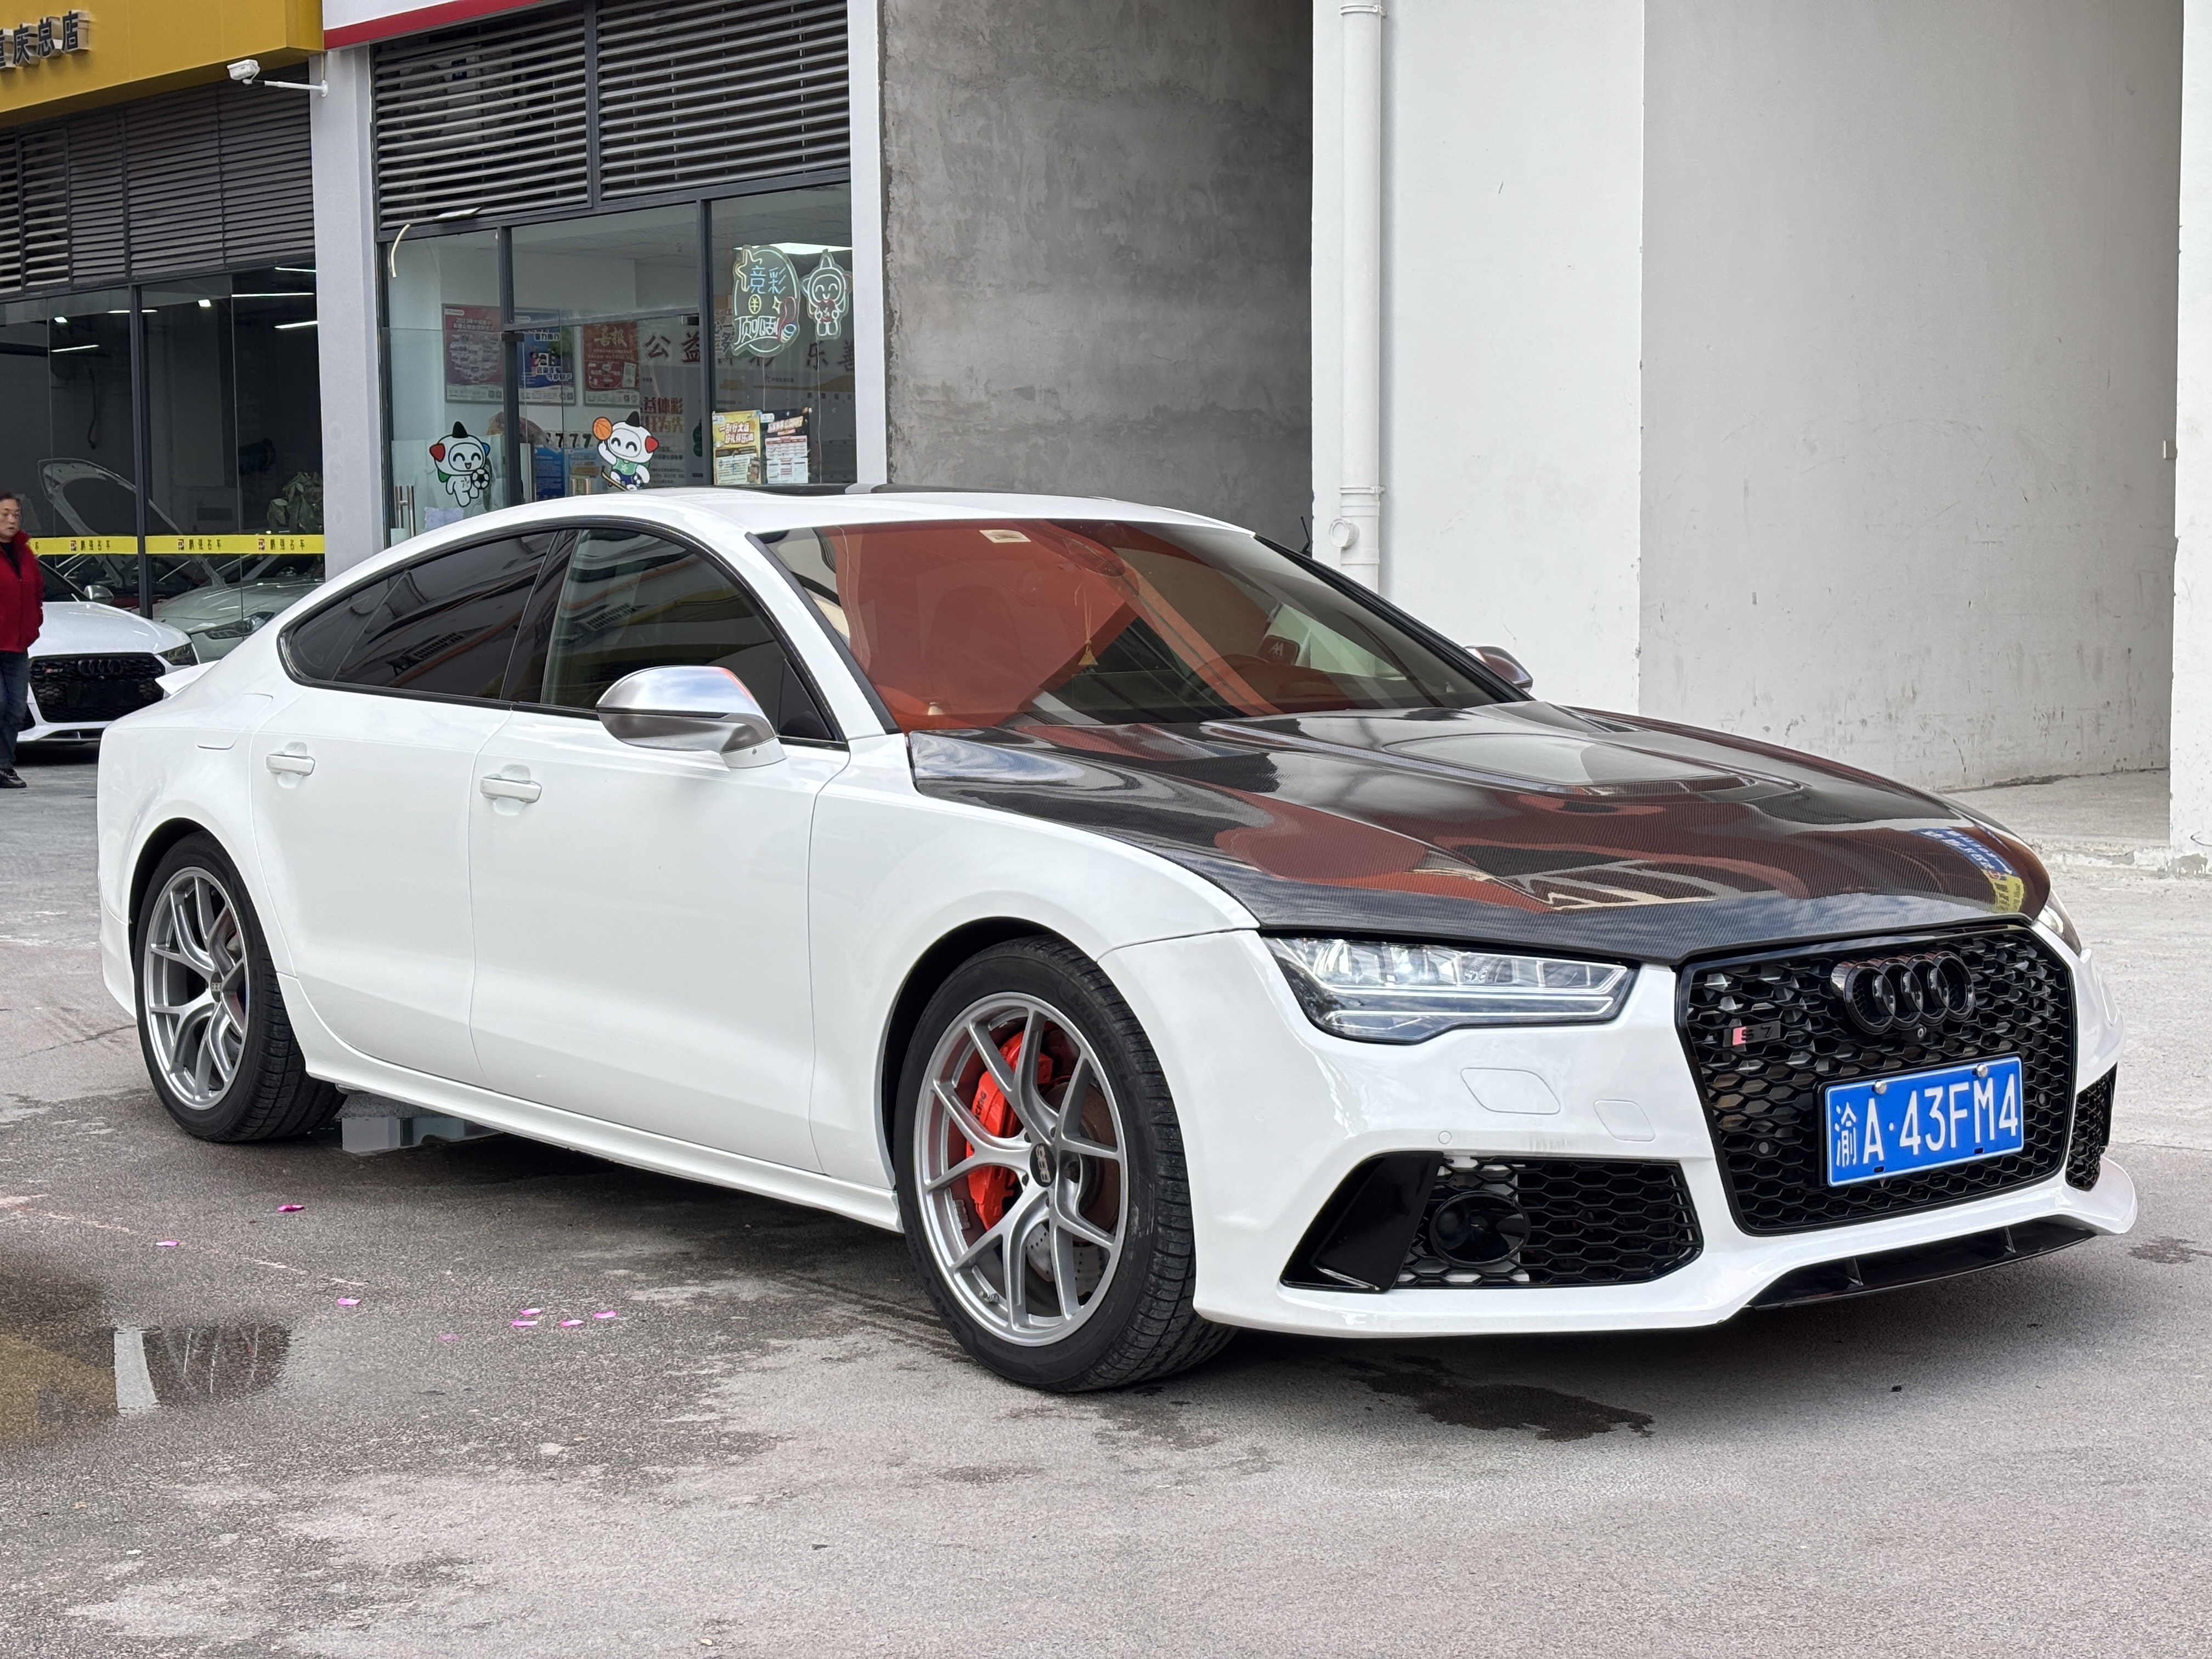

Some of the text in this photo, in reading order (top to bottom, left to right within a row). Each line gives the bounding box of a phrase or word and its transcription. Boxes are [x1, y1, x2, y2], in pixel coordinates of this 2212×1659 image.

[750, 265, 787, 294] 竞彩
[594, 325, 627, 347] 喜报
[733, 315, 780, 346] 顶呱刮
[640, 397, 684, 414] 益体彩
[641, 415, 685, 433] 任为先
[1035, 1146, 1051, 1183] BBS
